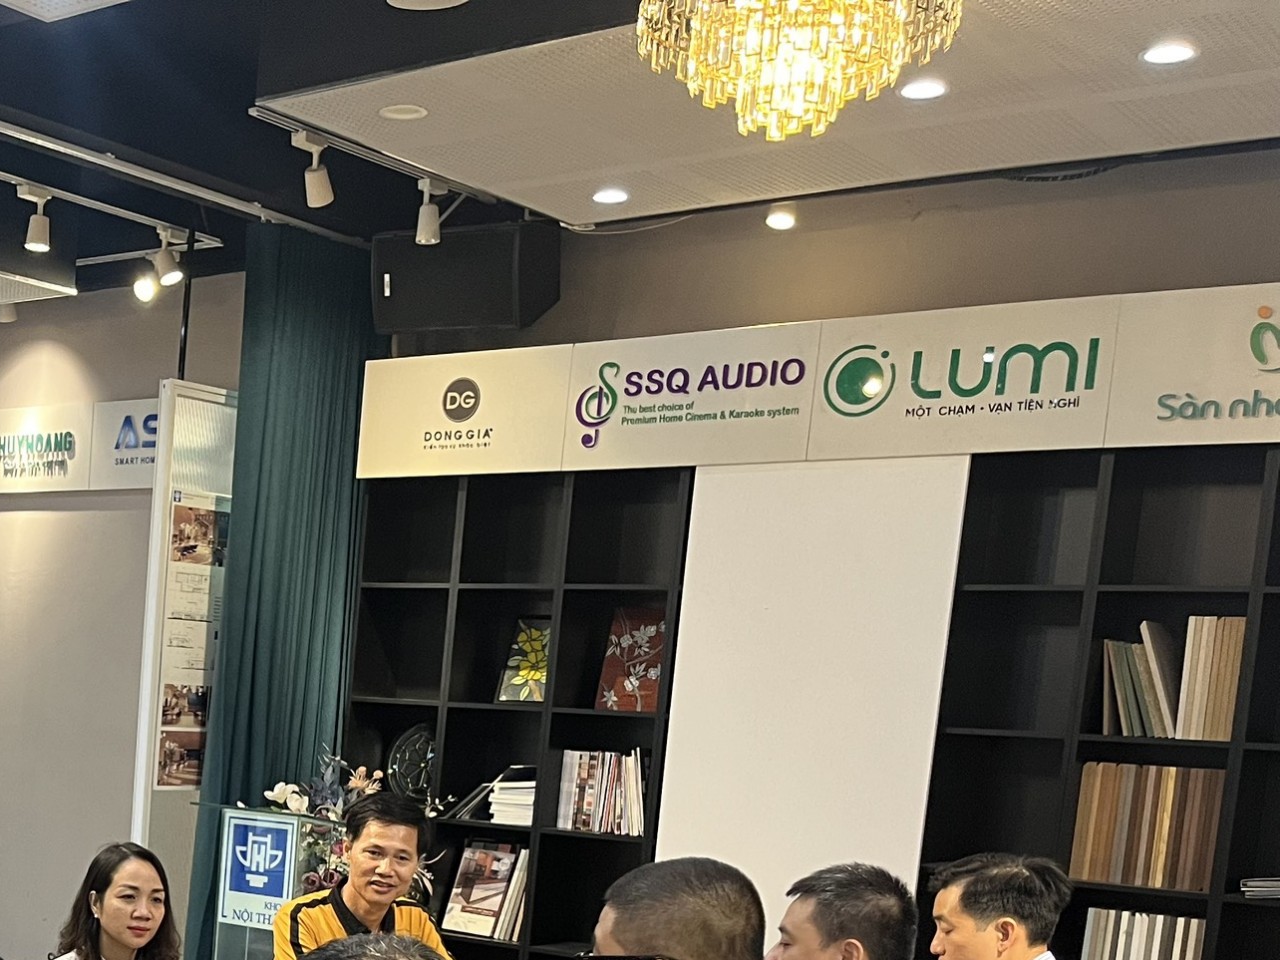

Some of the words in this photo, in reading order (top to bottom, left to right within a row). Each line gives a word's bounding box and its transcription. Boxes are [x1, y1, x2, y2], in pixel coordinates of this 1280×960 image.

[623, 367, 690, 397] SSQ
[697, 358, 806, 392] AUDIO
[445, 390, 476, 410] DG
[623, 405, 638, 414] The
[639, 403, 656, 413] best
[657, 402, 684, 412] choice
[685, 400, 695, 411] of
[1156, 392, 1222, 420] Sàn
[621, 414, 658, 426] Premium
[659, 413, 684, 423] Home
[685, 411, 718, 422] Cinema
[720, 410, 727, 420] &
[729, 408, 765, 419] Karaoke
[766, 405, 800, 419] system
[905, 404, 932, 420] MỘT
[938, 404, 975, 418] CHẠM
[988, 401, 1012, 415] VẠN
[114, 456, 139, 466] SMART
[231, 907, 253, 923] NỘI
